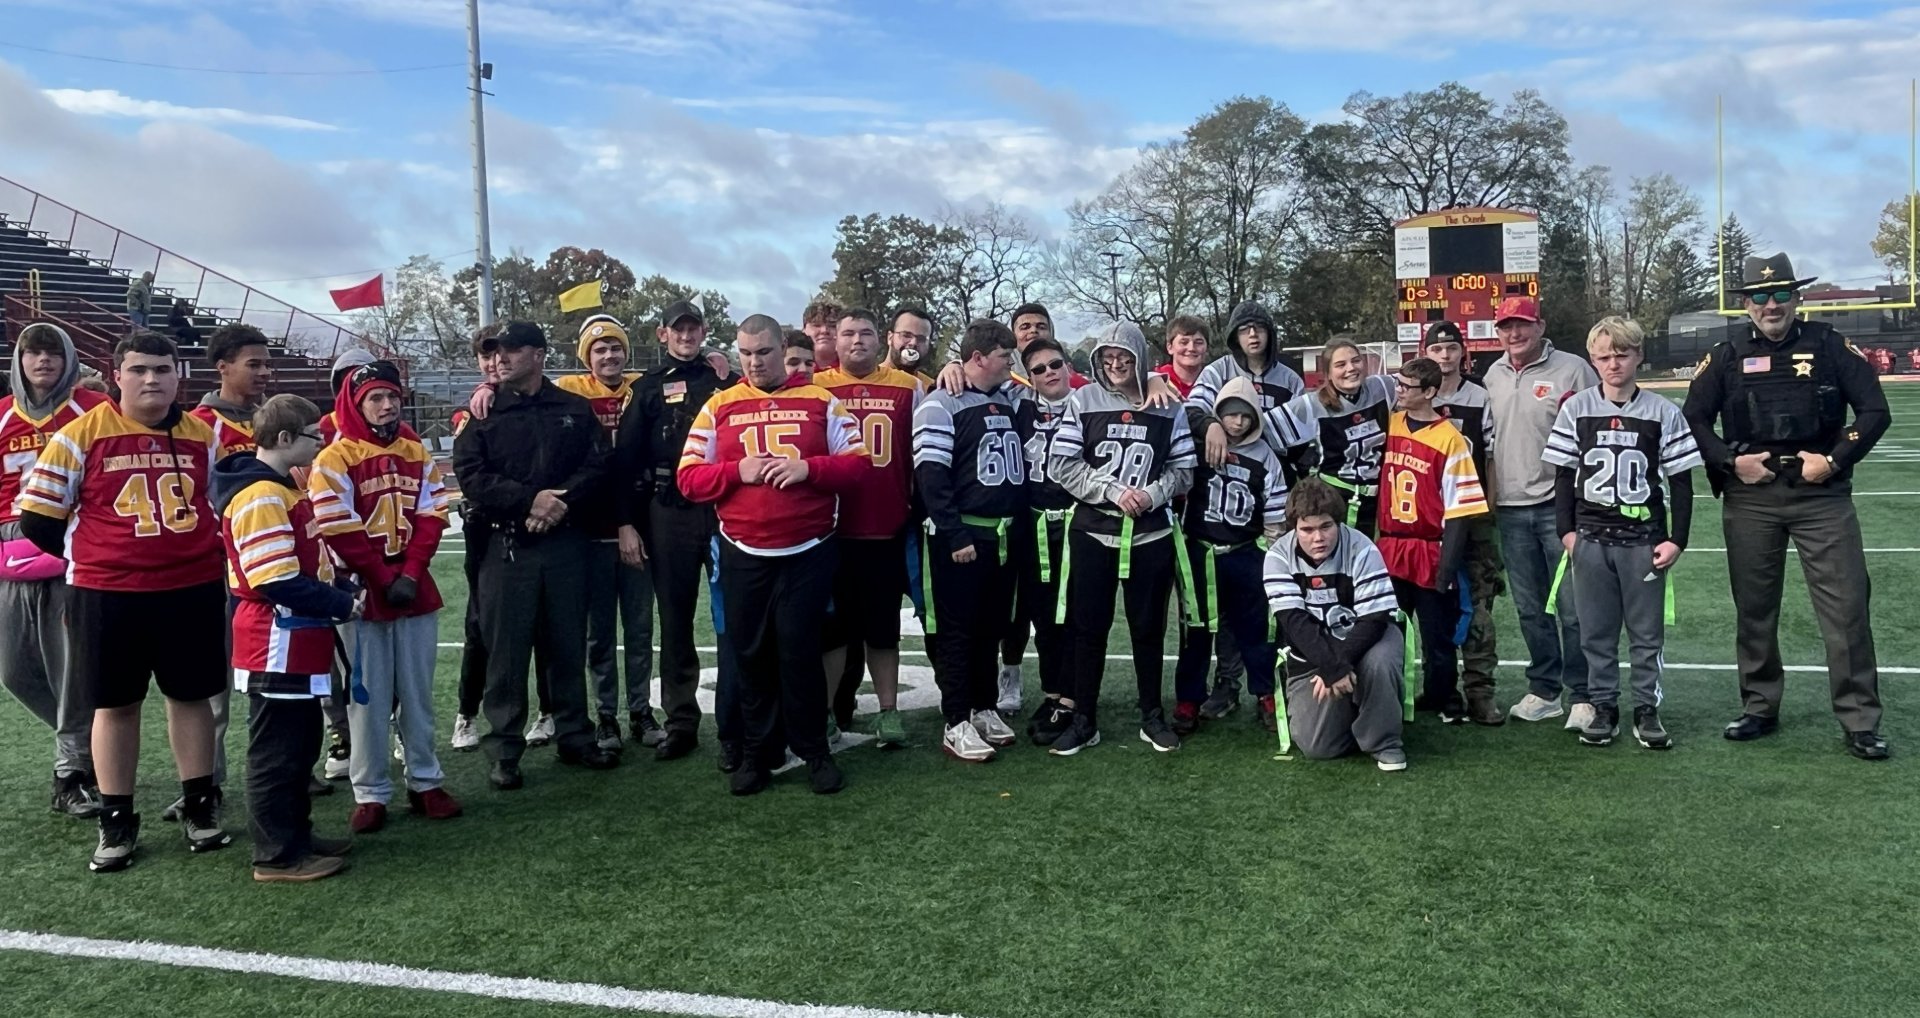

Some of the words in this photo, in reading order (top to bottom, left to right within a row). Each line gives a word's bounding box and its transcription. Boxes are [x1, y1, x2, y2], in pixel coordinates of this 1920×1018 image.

[1406, 286, 1416, 301] 0
[1452, 275, 1486, 290] 10:00
[1528, 281, 1538, 297] 0
[739, 423, 801, 461] 15
[977, 431, 1025, 487] 60
[1095, 441, 1155, 489] 28
[1337, 432, 1387, 481] 15
[1203, 474, 1256, 527] 10
[1387, 465, 1418, 524] 18
[1583, 447, 1651, 505] 20
[112, 472, 199, 537] 48
[364, 491, 416, 557] 45
